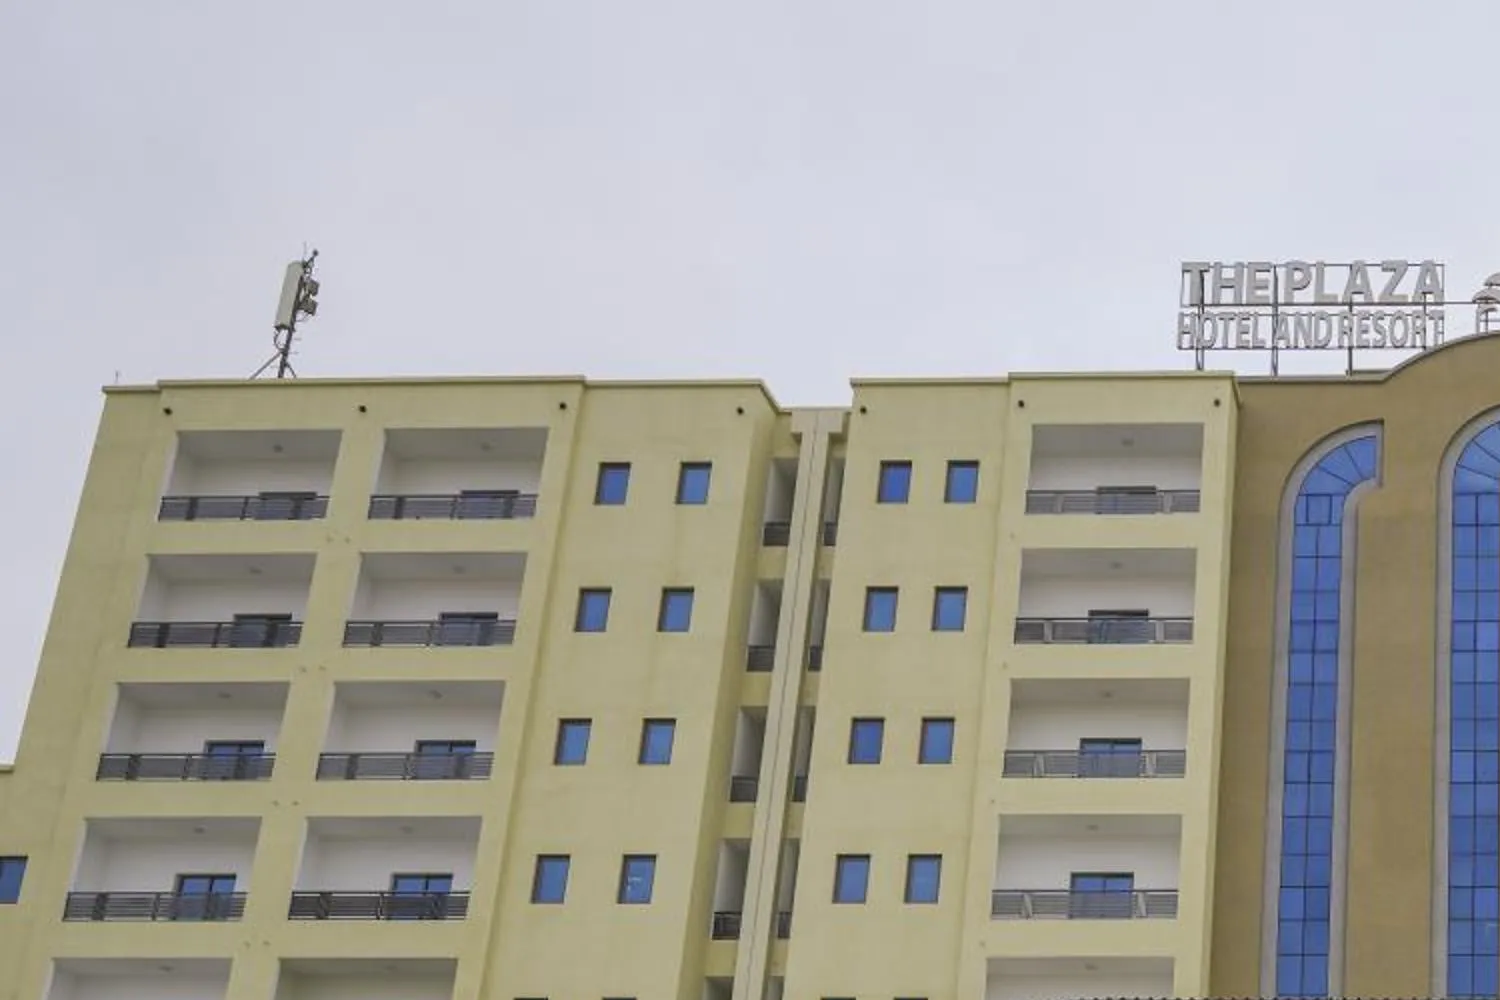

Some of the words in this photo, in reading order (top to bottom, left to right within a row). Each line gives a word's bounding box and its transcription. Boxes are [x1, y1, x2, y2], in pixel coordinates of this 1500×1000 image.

[1181, 261, 1272, 305] THE
[1284, 260, 1444, 305] PLAZA
[1177, 312, 1266, 350] HOTEL
[1275, 312, 1332, 350] AND
[1338, 310, 1444, 350] RESORT
